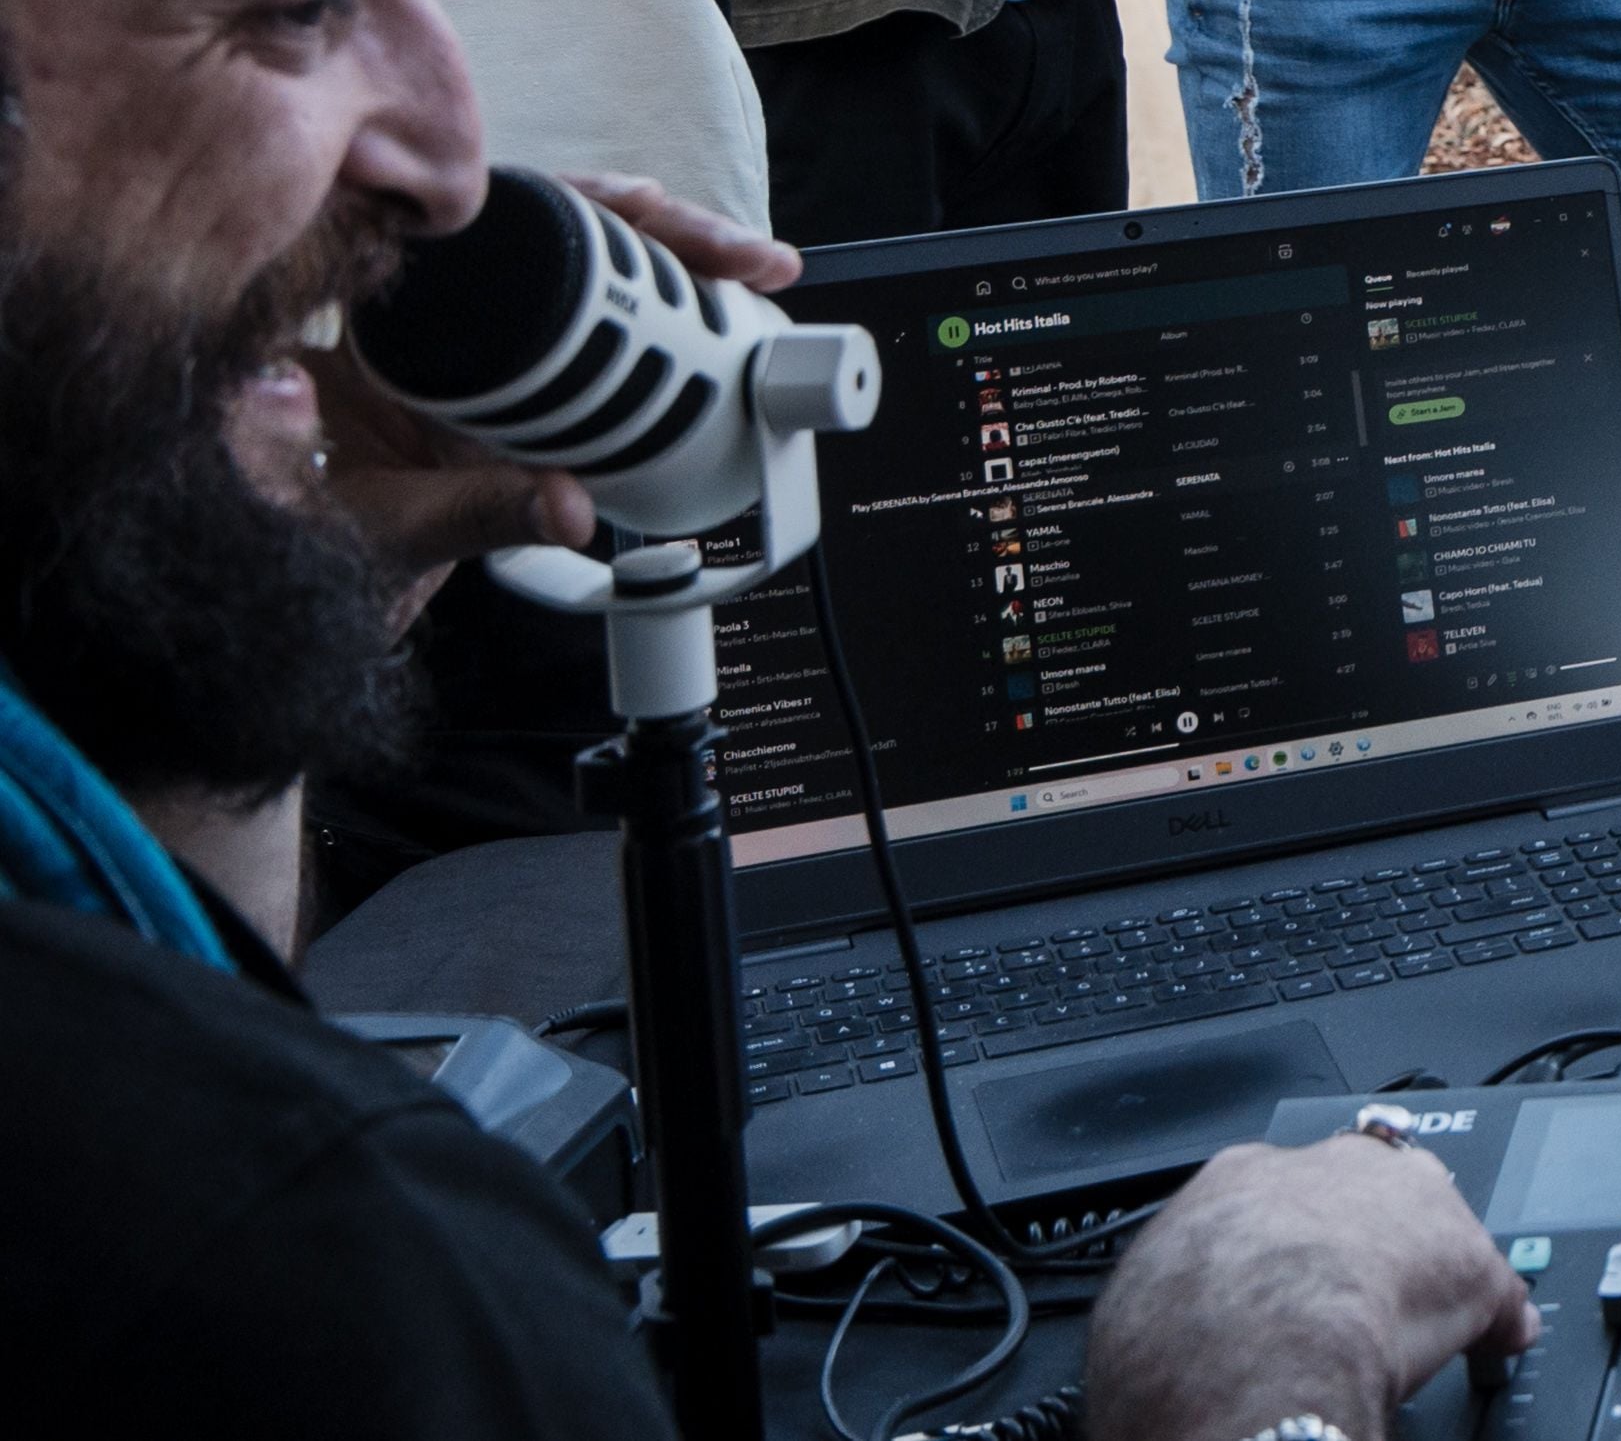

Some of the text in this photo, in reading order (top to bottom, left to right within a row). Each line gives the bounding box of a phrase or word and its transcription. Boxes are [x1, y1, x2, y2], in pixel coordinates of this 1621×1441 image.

[1034, 262, 1158, 286] What do you want to play?
[1364, 274, 1393, 284] Queue
[1405, 263, 1470, 279] Recently played
[1365, 296, 1423, 310] Now playing
[974, 312, 1071, 337] Hot Hits Italia
[1160, 331, 1188, 341] Album
[973, 355, 993, 364] Title
[1434, 373, 1446, 382] to
[1011, 374, 1138, 398] Kriminal Prod. by Roberto
[1014, 422, 1035, 433] Che
[1035, 418, 1066, 430] Gusto
[1108, 407, 1141, 420] Tredici
[1383, 441, 1496, 465] Next from: Hot Hits Italia
[1018, 456, 1048, 468] capaz
[1175, 472, 1221, 487] SERENATA
[1423, 468, 1485, 484] Umore marea
[851, 504, 872, 514] Play
[871, 496, 921, 511] SERENATA
[917, 495, 932, 505] by
[929, 491, 963, 503] Serena
[1001, 479, 1050, 492] Alessandra
[1049, 474, 1089, 486] Amoroso
[1022, 487, 1075, 503] SERENATA
[1036, 503, 1067, 514] Serena
[1428, 495, 1556, 522] Nonostante Tutto (feat. Elisa)
[1025, 524, 1063, 538] YAMAL
[705, 539, 735, 551] Paola
[1433, 537, 1537, 562] CHIAMO IO CHIAMI TU
[1029, 560, 1071, 574] Maschio
[1438, 576, 1544, 601] Capo Horn (feat. Tedua)
[1033, 596, 1064, 609] NEON
[713, 623, 743, 635] Paola
[1037, 623, 1117, 645] SCELTE STUPIDE
[1443, 625, 1486, 640] 7ELEVEN
[716, 663, 753, 677] Mirella
[1040, 663, 1107, 681] Umore marea
[720, 698, 803, 719] Domenica Vibes
[1044, 700, 1102, 716] Nonostante
[1102, 696, 1129, 707] Tutto
[1128, 691, 1154, 704] (feat.
[1154, 685, 1181, 699] Elisa)
[723, 742, 797, 761] Chiacchierone
[729, 783, 805, 805] SCELTE STUPIDE
[1059, 788, 1089, 801] Search
[1167, 809, 1232, 837] DELL
